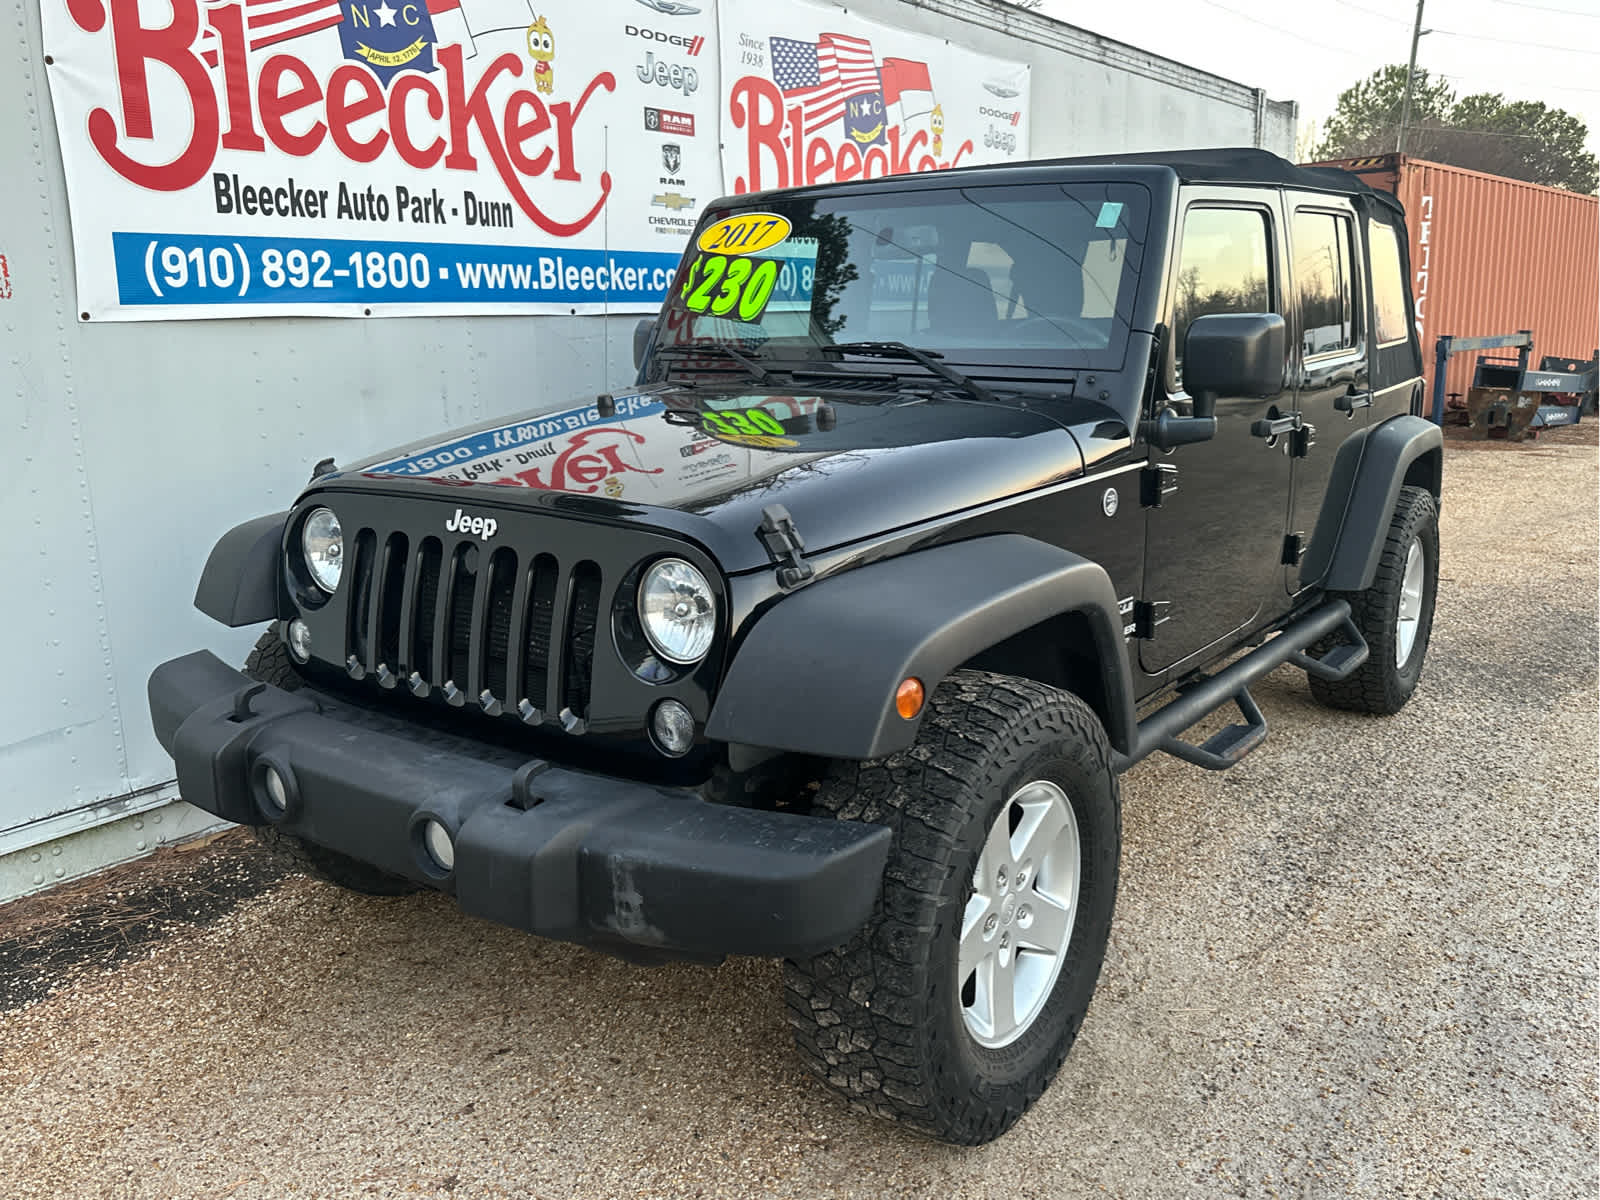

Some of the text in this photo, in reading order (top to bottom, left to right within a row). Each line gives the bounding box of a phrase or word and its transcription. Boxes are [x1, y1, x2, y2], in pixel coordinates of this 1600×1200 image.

[351, 4, 420, 28] N C
[625, 25, 694, 49] DODGE
[739, 32, 764, 51] Since
[369, 51, 391, 64] APRIL
[741, 50, 764, 68] 1938
[636, 51, 699, 96] Jeep
[67, 0, 616, 237] Bleecker
[662, 114, 692, 127] RAM
[979, 106, 1016, 121] DODGE
[983, 124, 1017, 156] Jeep
[659, 177, 686, 187] RAM
[213, 173, 514, 229] Bleecker Auto Park Dunn
[708, 220, 780, 249] 2017
[144, 240, 677, 297] (910) 892-1800 www.Bleecker.co
[680, 254, 777, 321] $230
[446, 509, 497, 540] Jeep
